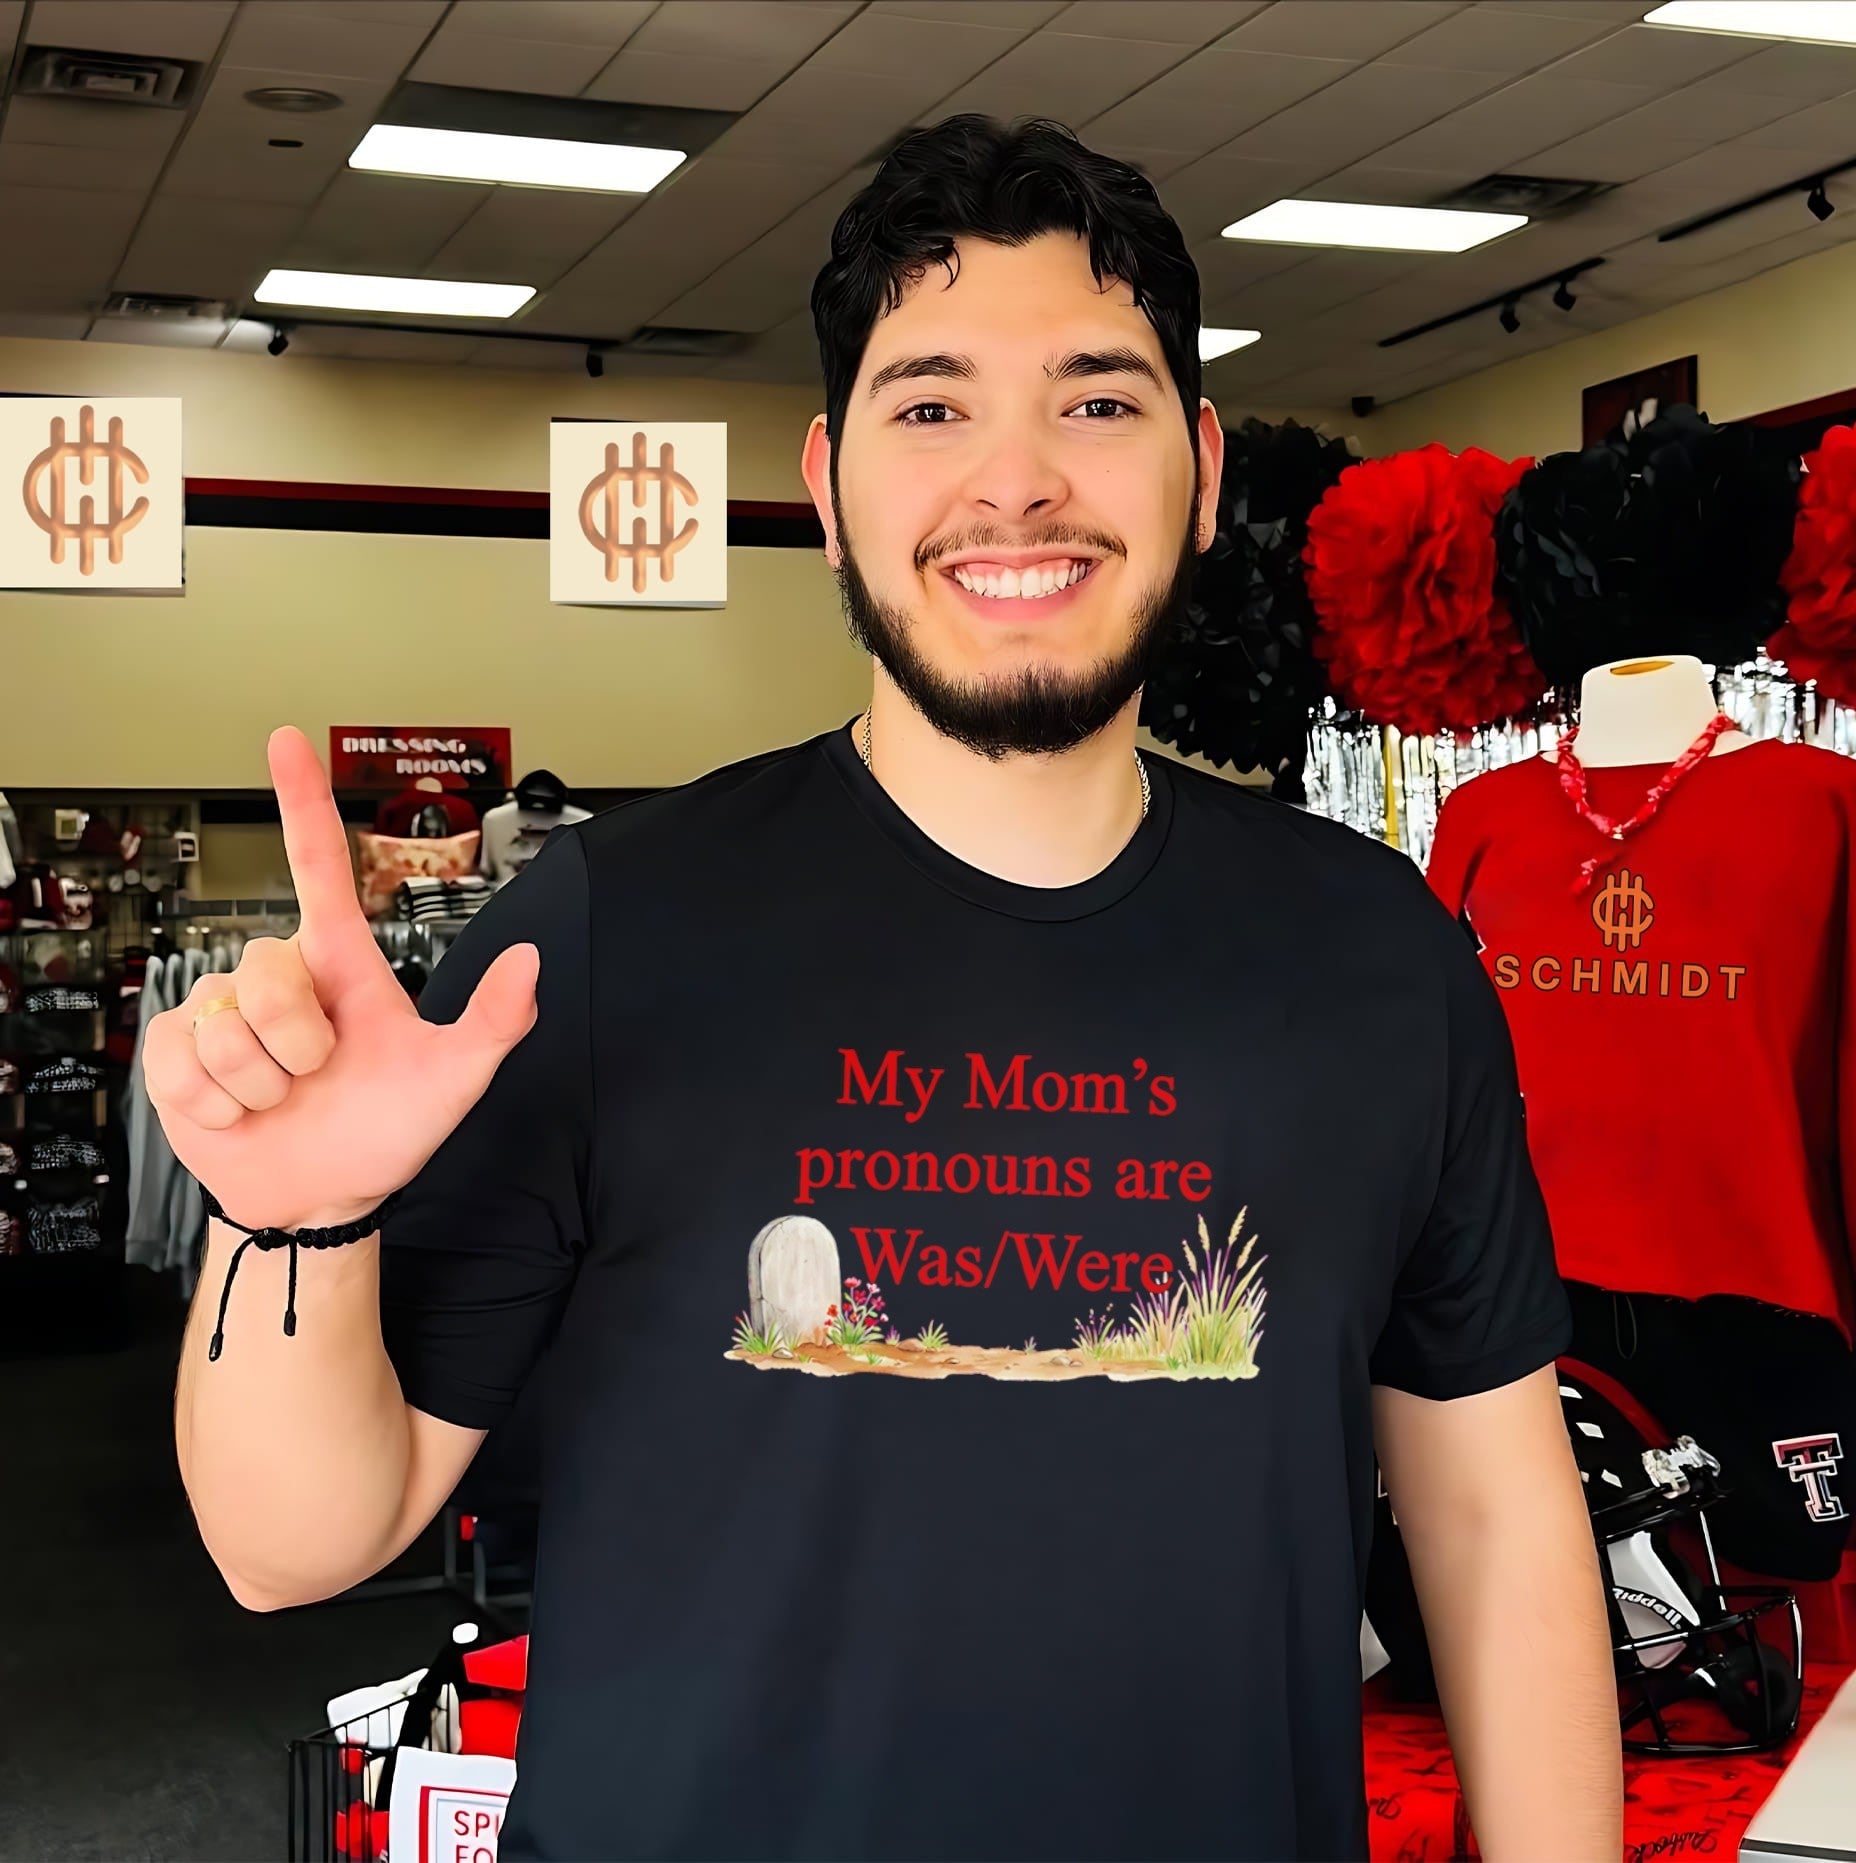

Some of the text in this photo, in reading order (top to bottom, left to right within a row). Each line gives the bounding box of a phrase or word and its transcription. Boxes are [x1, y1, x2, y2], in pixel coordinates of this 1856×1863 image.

[342, 737, 467, 753] DRESSING
[396, 758, 488, 775] ROOMS
[1494, 953, 1747, 1000] SCHMIDT
[836, 1048, 945, 1123] My
[794, 1147, 1213, 1204] pronouns are
[850, 1227, 1174, 1294] Was/Were
